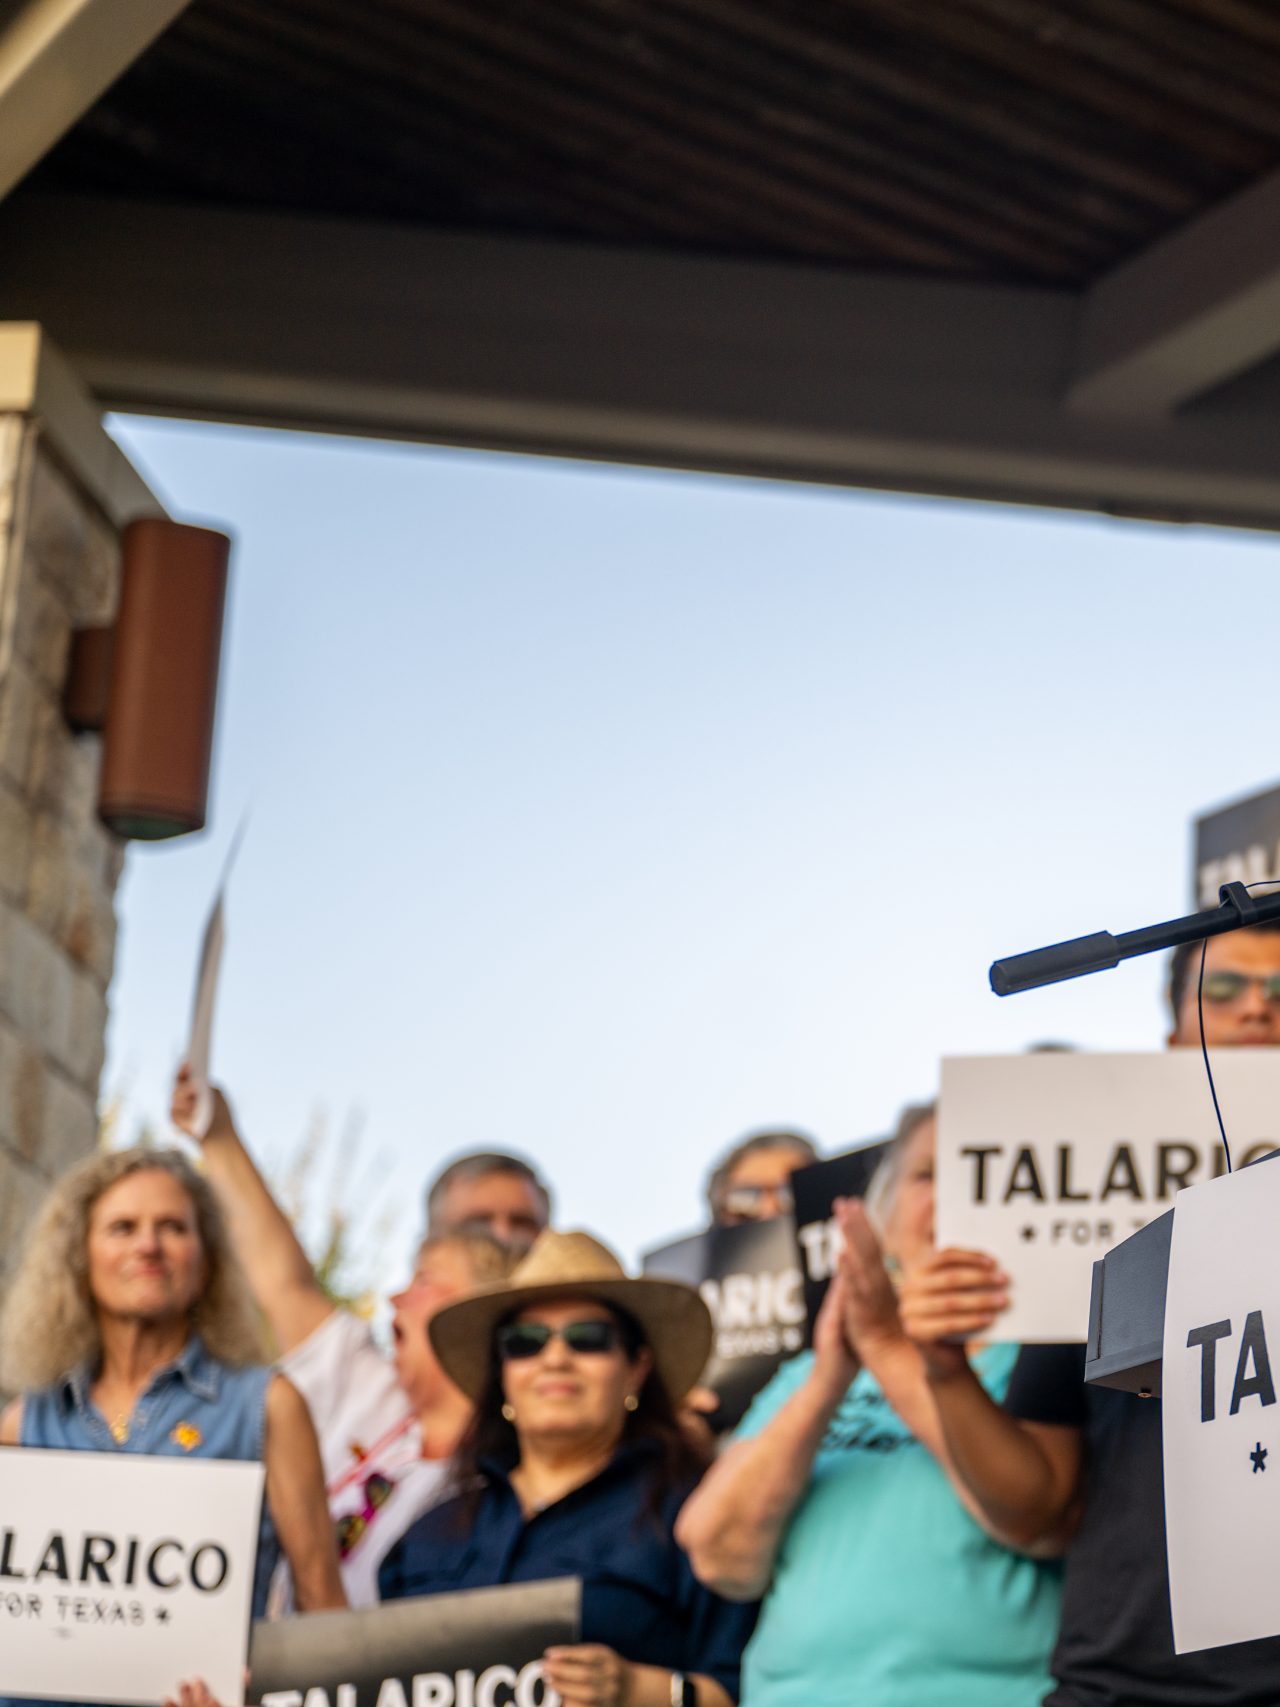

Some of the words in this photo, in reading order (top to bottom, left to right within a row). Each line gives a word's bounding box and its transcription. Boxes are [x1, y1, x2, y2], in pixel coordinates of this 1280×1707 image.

[1050, 1216, 1114, 1246] FOR
[0, 1530, 229, 1593] LARICO
[53, 1596, 146, 1627] TEXAS
